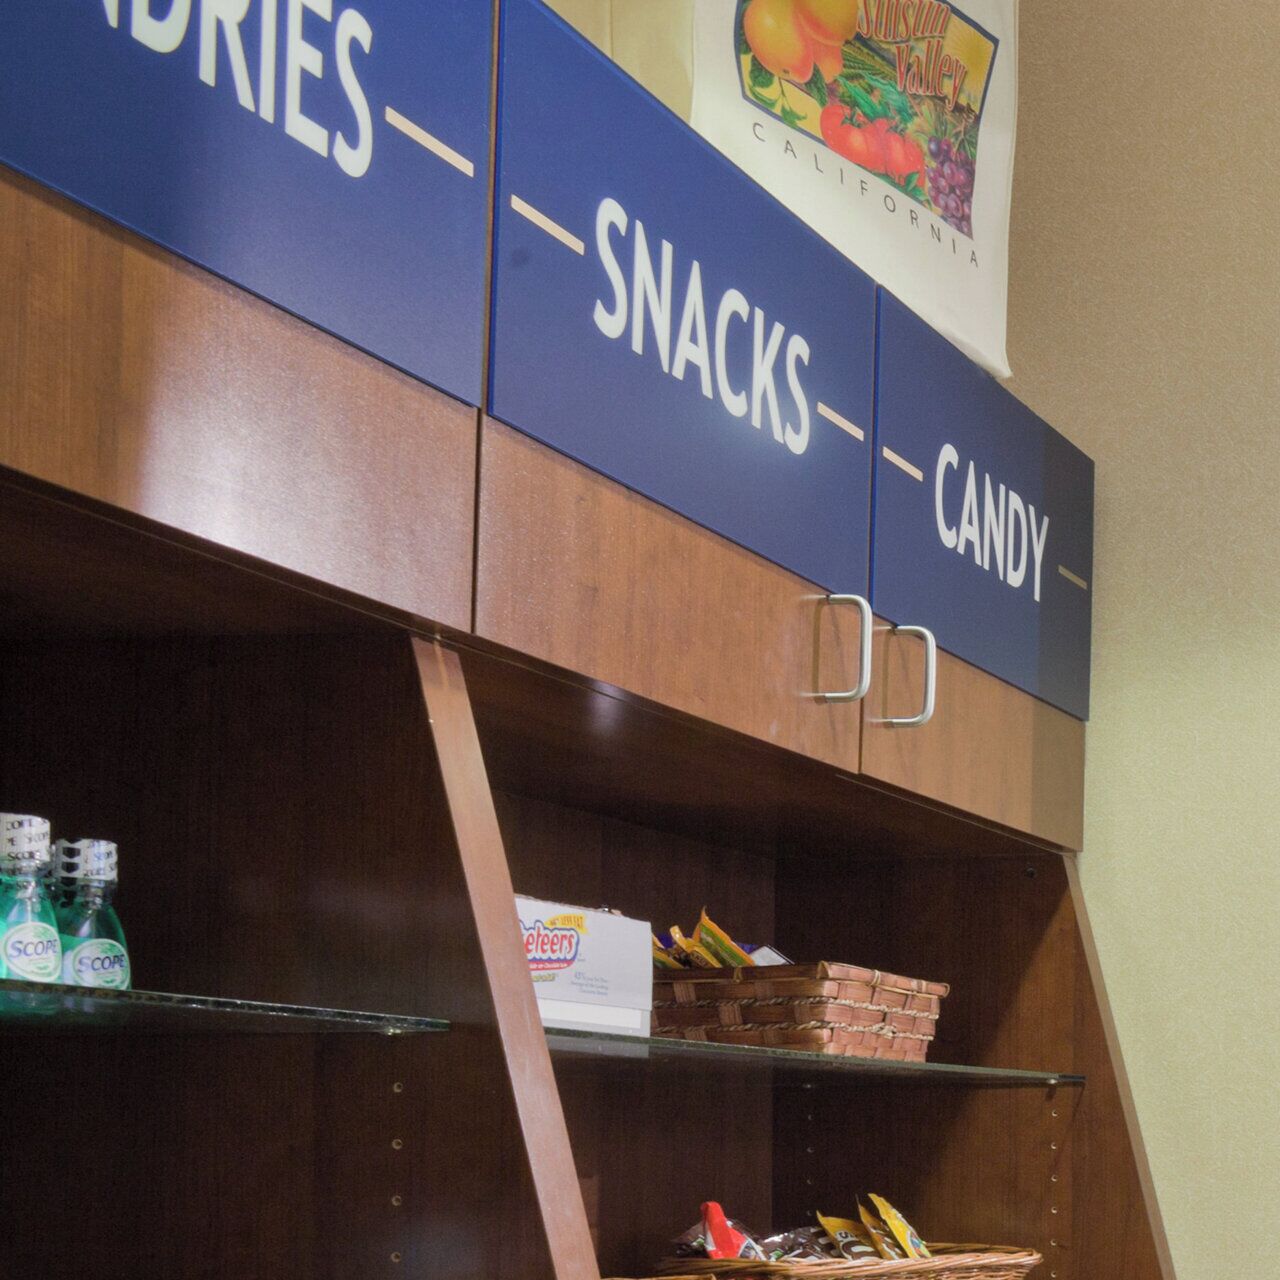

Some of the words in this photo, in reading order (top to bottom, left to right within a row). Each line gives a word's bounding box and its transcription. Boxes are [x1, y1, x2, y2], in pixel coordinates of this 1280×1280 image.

[894, 38, 968, 110] Valley
[753, 122, 979, 268] CALIFORNIA
[593, 197, 811, 456] SNACKS
[935, 443, 1050, 603] CANDY
